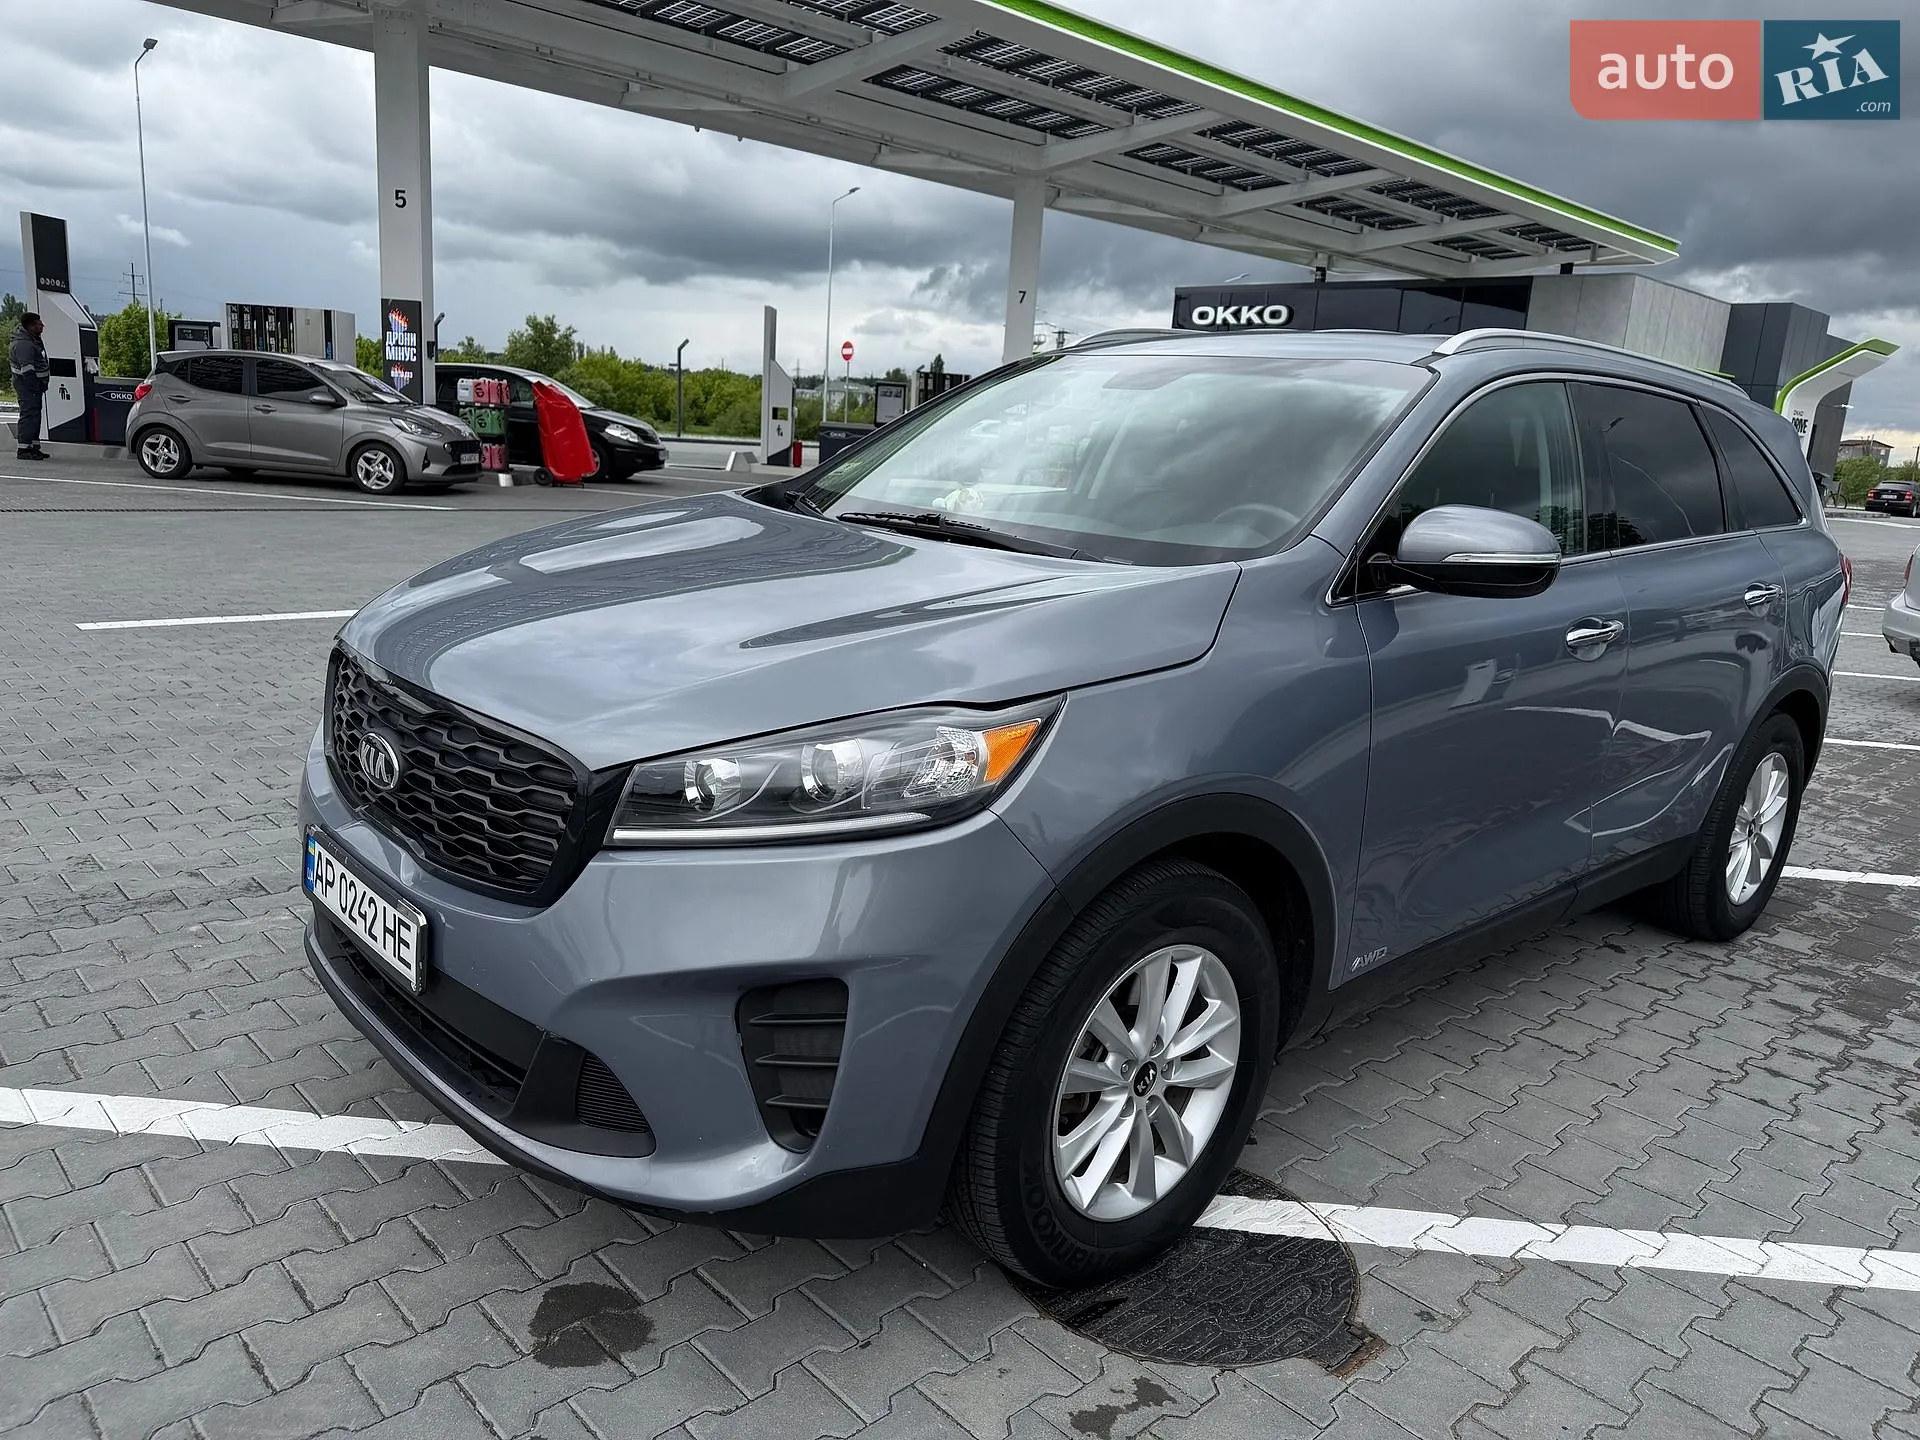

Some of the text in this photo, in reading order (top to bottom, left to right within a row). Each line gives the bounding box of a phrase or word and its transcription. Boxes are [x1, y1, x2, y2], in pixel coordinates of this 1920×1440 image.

[395, 189, 407, 209] 5
[1018, 290, 1027, 304] 7
[1191, 304, 1289, 326] OKKO
[385, 331, 417, 347] ДРОНИ
[385, 346, 417, 362] МІНУС
[110, 392, 133, 400] OKKO
[360, 740, 389, 783] KIA
[314, 850, 412, 972] AP 0242 HE
[1351, 946, 1388, 972] AWD
[1136, 1068, 1157, 1093] KIA
